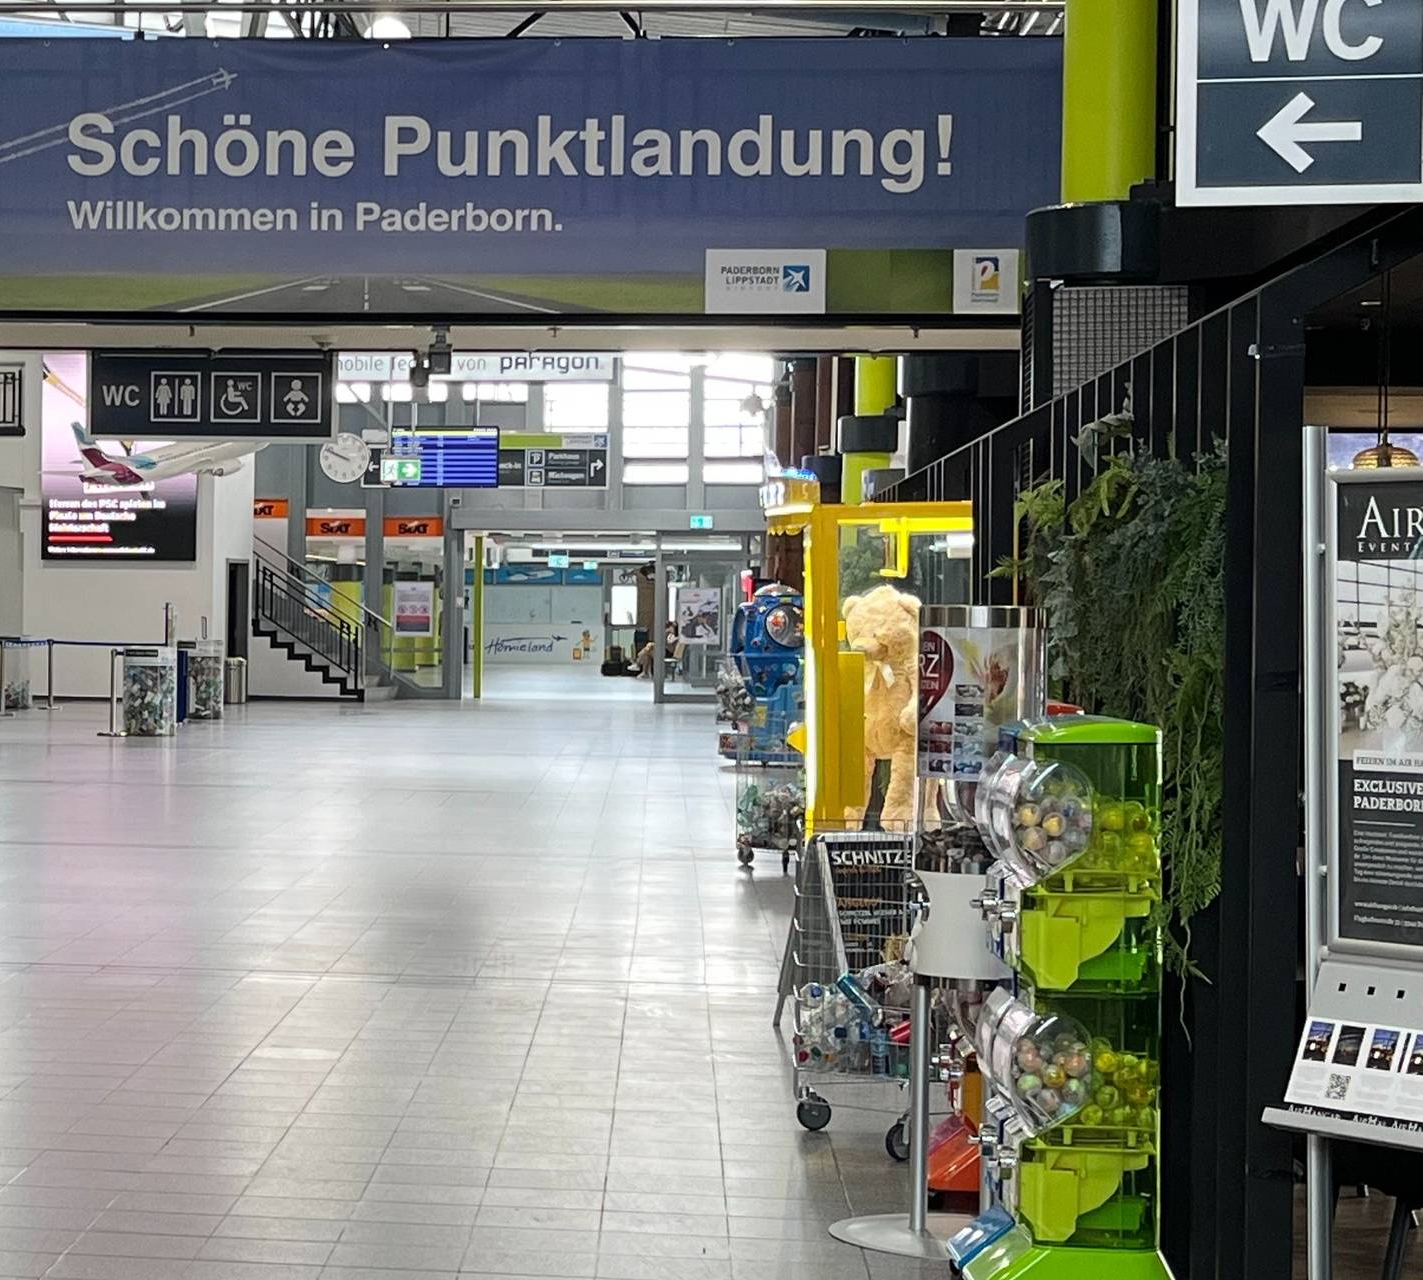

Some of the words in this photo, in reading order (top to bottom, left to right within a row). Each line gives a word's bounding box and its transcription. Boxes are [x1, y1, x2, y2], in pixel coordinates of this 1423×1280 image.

[1239, 0, 1384, 62] WC
[66, 111, 355, 178] Schöne
[383, 113, 954, 194] Punktlandung!
[66, 200, 298, 232] Willkommen
[310, 201, 344, 232] in
[356, 202, 563, 233] Paderborn.
[720, 265, 780, 275] PADERBORN
[725, 275, 780, 285] LIPPSTADT
[457, 358, 486, 371] von
[237, 381, 253, 391] WC
[102, 385, 140, 407] WC
[254, 505, 274, 516] IXT
[1353, 778, 1423, 796] EXCLUSIVE
[1352, 795, 1423, 813] PADERBOR
[831, 850, 912, 866] SCHNITZE
